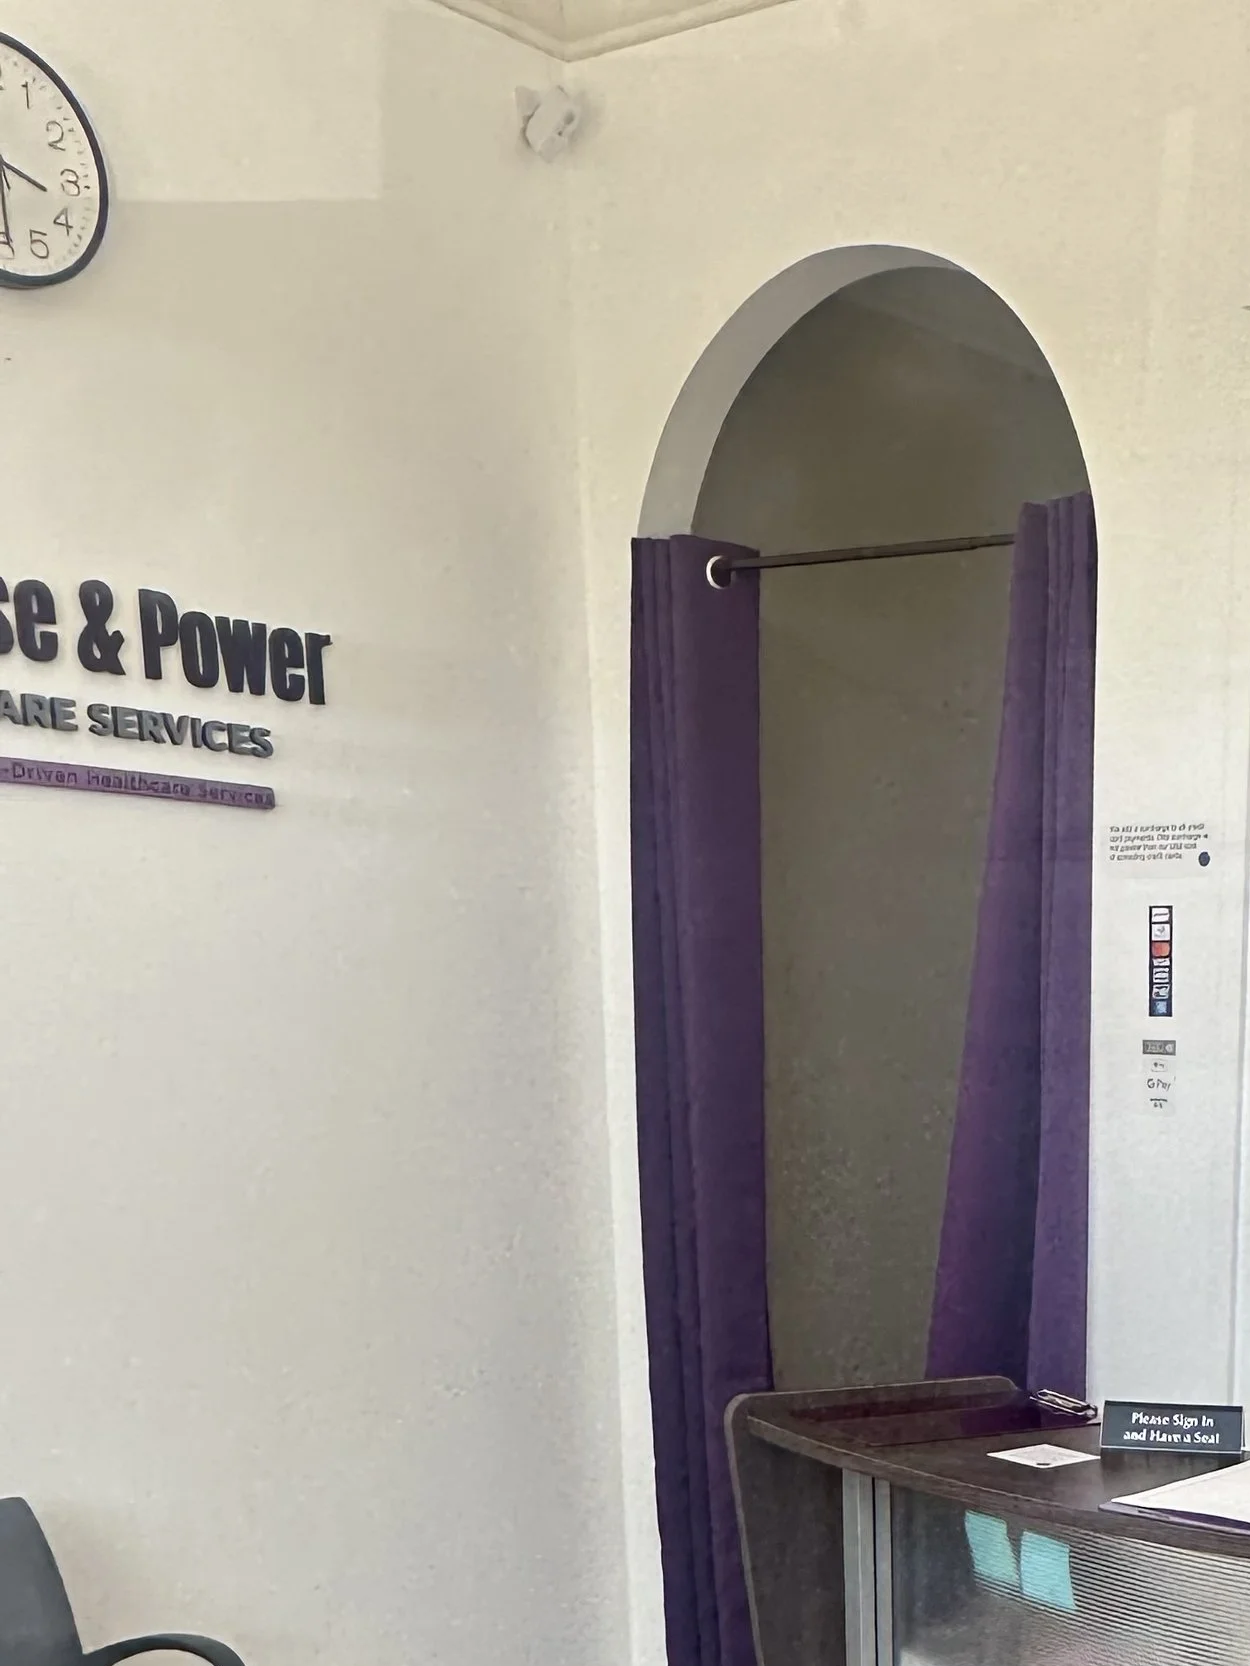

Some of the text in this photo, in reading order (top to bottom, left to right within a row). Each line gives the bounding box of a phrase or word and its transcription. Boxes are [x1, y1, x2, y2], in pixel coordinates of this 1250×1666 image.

[45, 120, 67, 152] 2
[60, 168, 82, 198] 3
[53, 207, 74, 237] 4
[29, 229, 50, 260] 5
[77, 579, 126, 676] &
[138, 588, 333, 706] Power
[87, 702, 275, 760] SERVICES
[87, 770, 191, 797] Healthcare
[1131, 1412, 1214, 1430] Please Sign In
[1123, 1429, 1220, 1445] and Have a Seat
